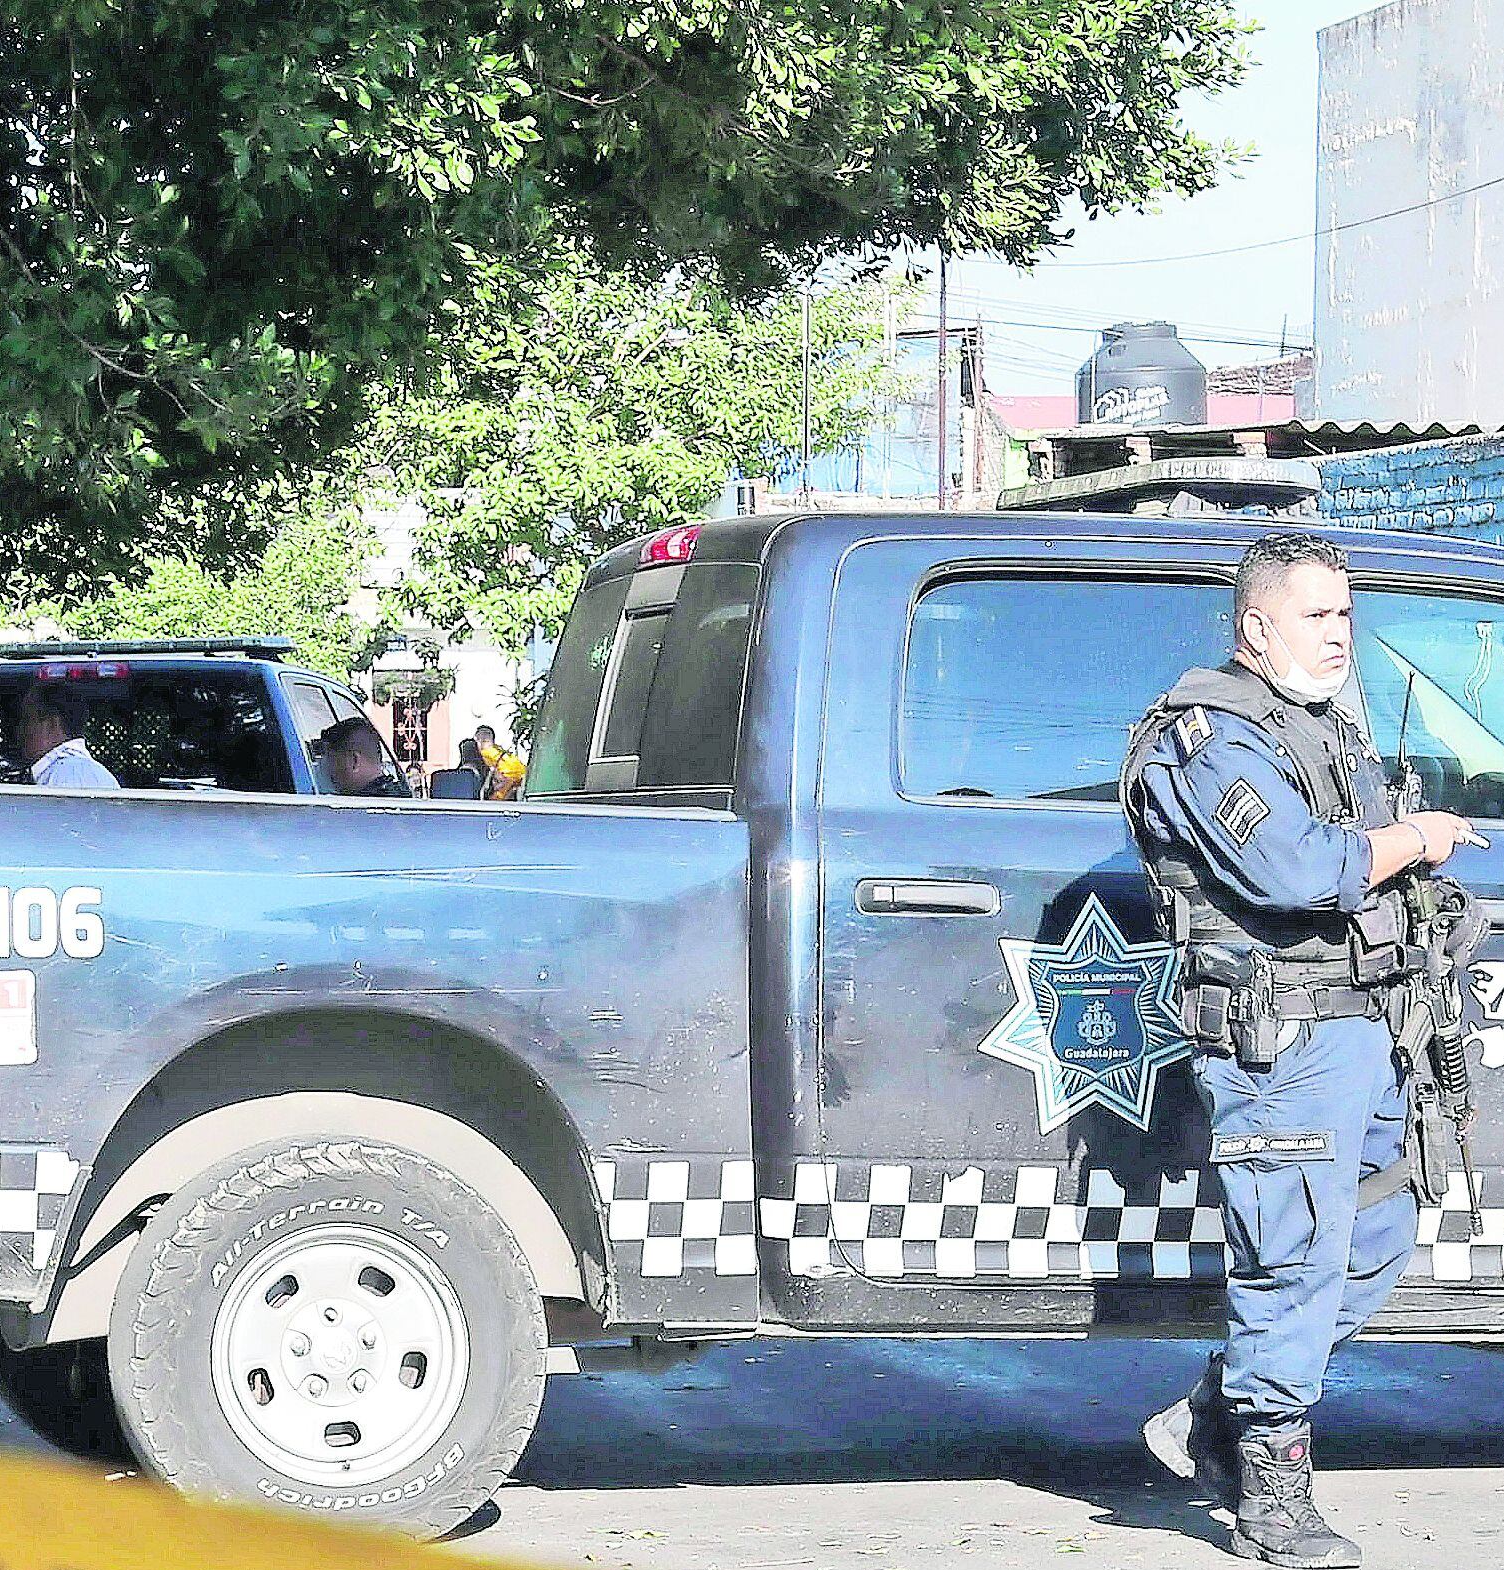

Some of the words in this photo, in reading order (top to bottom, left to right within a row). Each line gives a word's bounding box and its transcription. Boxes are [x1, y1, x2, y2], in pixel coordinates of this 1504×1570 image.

[1063, 1046, 1131, 1061] Guadalajara
[211, 1195, 386, 1288] All-Terrain
[401, 1207, 451, 1249] T/A
[257, 1442, 465, 1511] BFGoodrich
